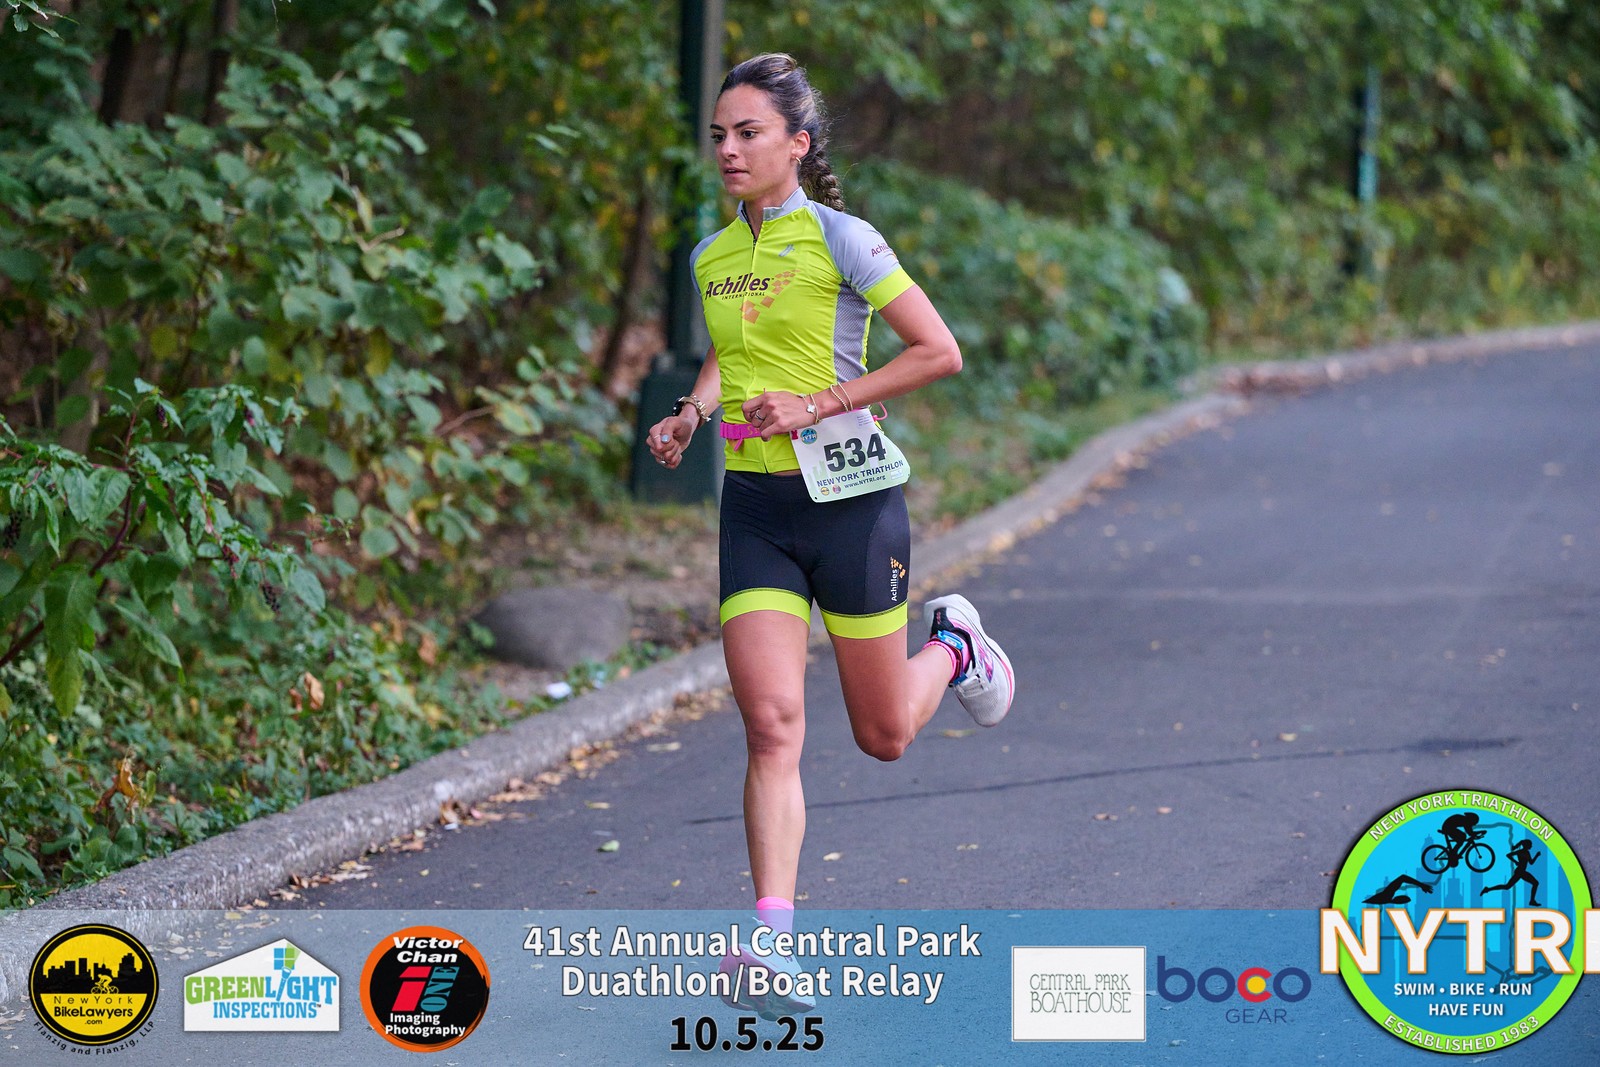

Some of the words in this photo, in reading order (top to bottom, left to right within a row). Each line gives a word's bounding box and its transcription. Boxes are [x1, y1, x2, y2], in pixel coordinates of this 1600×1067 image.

[705, 272, 770, 300] Achilles
[722, 292, 765, 300] INTERNTIONAL
[823, 433, 886, 472] 534
[817, 477, 835, 487] NEW
[835, 472, 860, 483] YORK
[860, 460, 904, 477] TRIATHLON
[844, 475, 886, 488] www.NYTRI.org
[890, 569, 898, 601] Achilles
